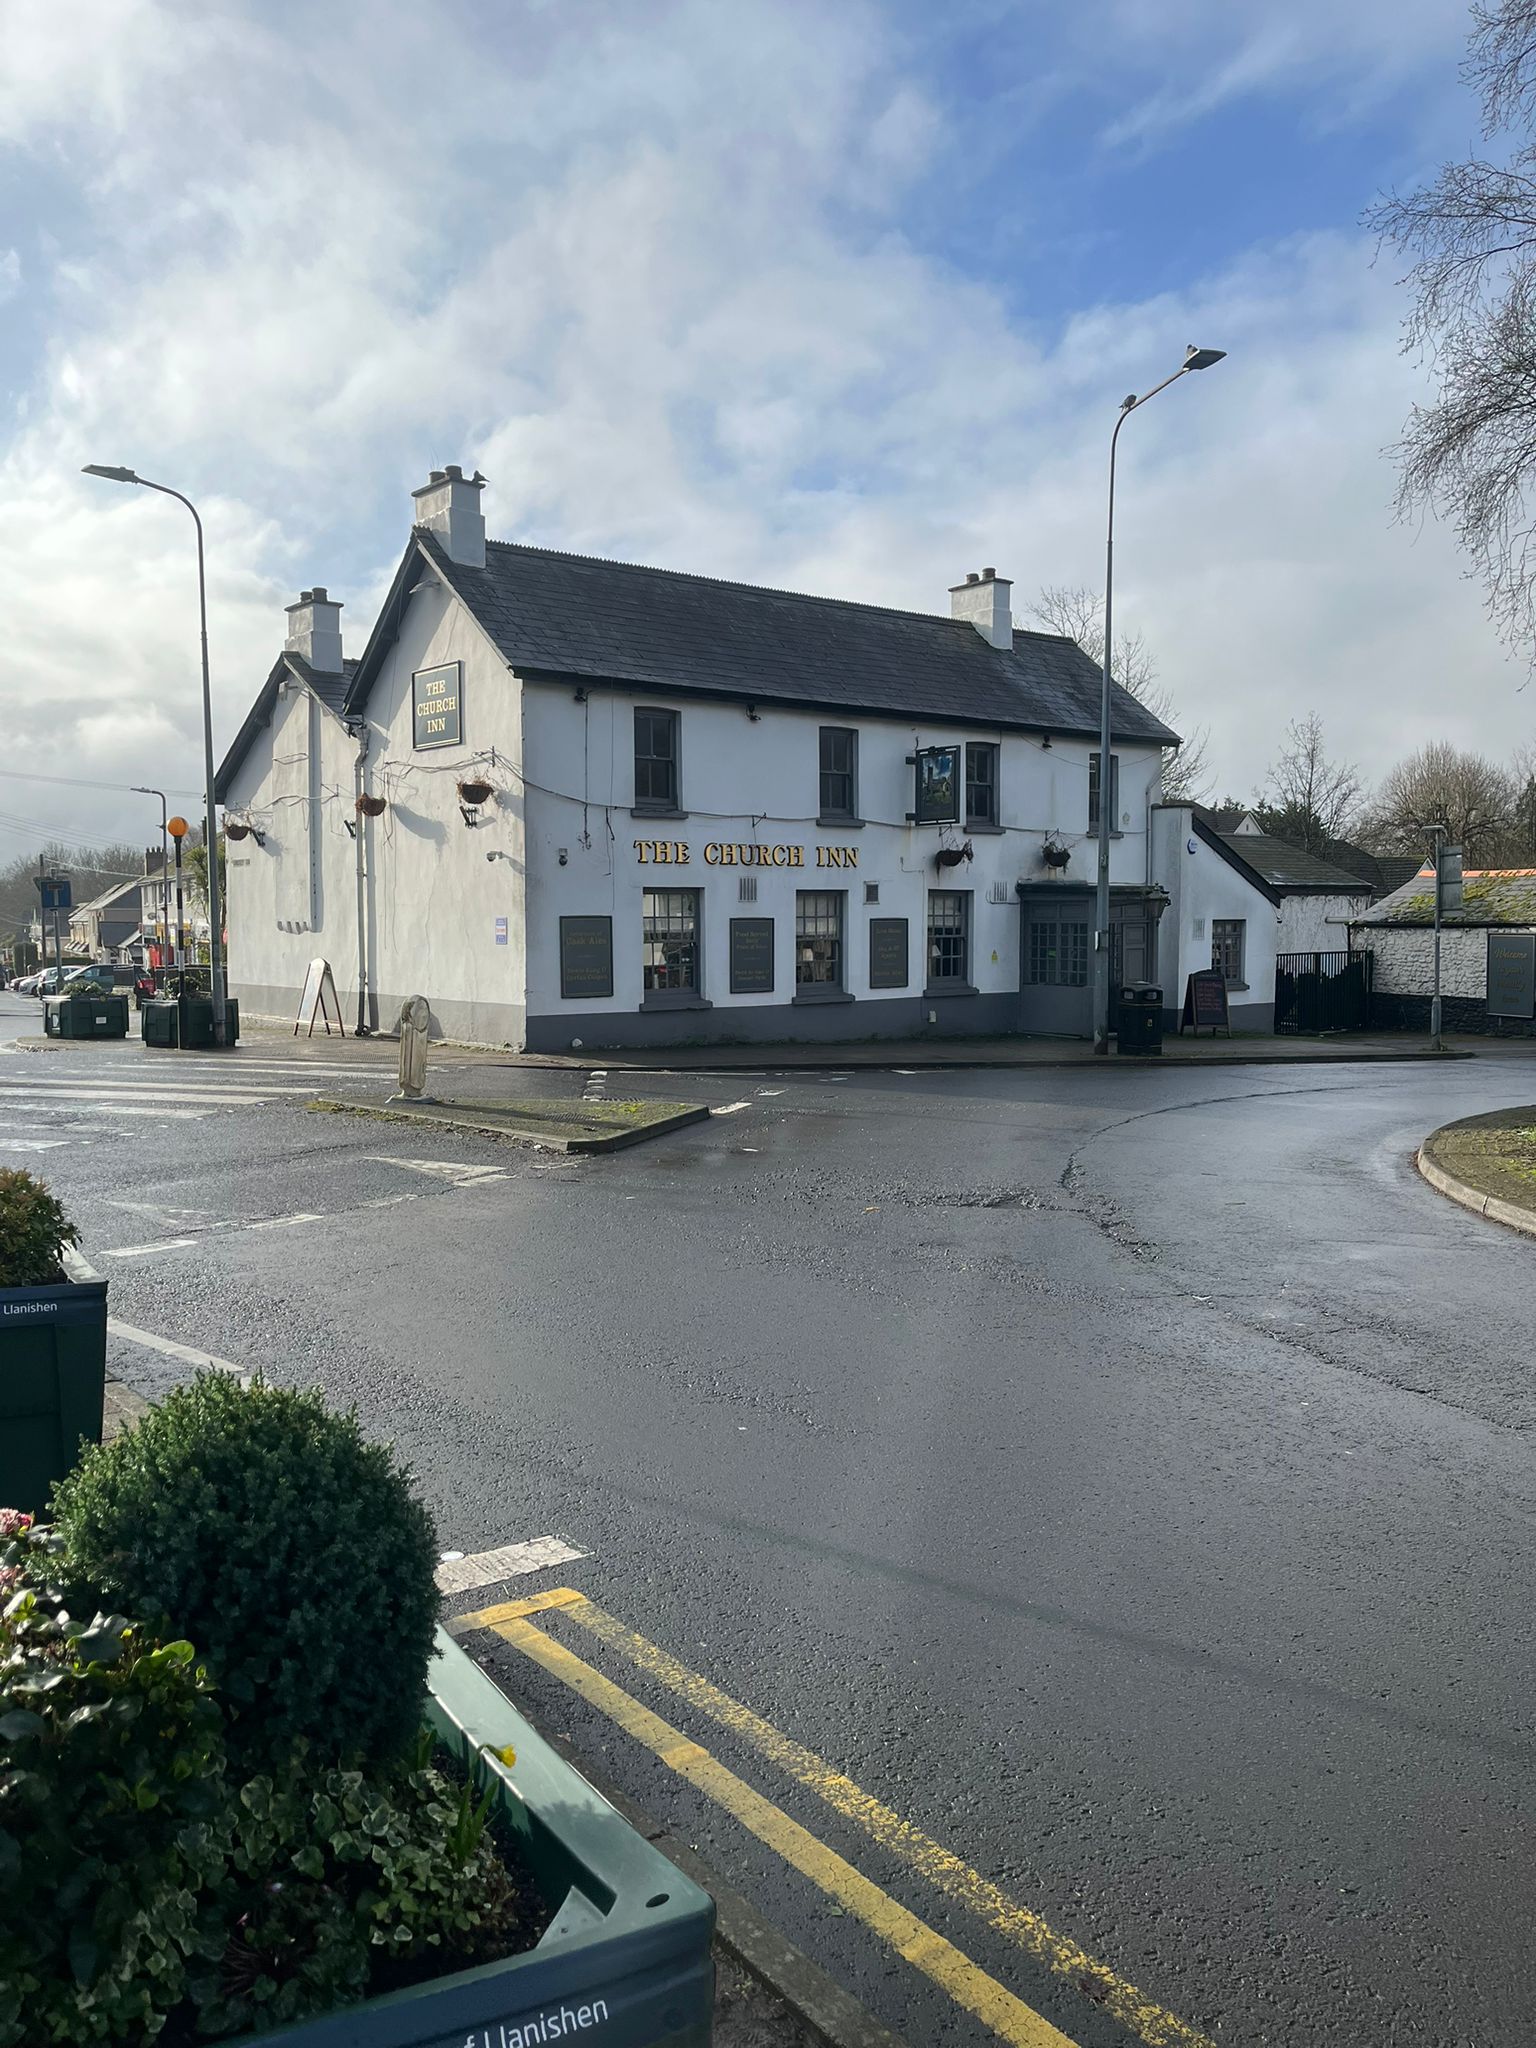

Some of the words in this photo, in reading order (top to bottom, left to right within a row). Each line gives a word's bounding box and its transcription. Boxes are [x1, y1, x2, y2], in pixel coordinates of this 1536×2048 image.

[426, 680, 446, 696] THE
[417, 697, 456, 717] CHURCH
[427, 718, 446, 734] INN
[633, 840, 691, 864] THE
[704, 843, 805, 868] CHURCH
[816, 846, 859, 868] INN
[3, 1302, 58, 1315] Llanishen
